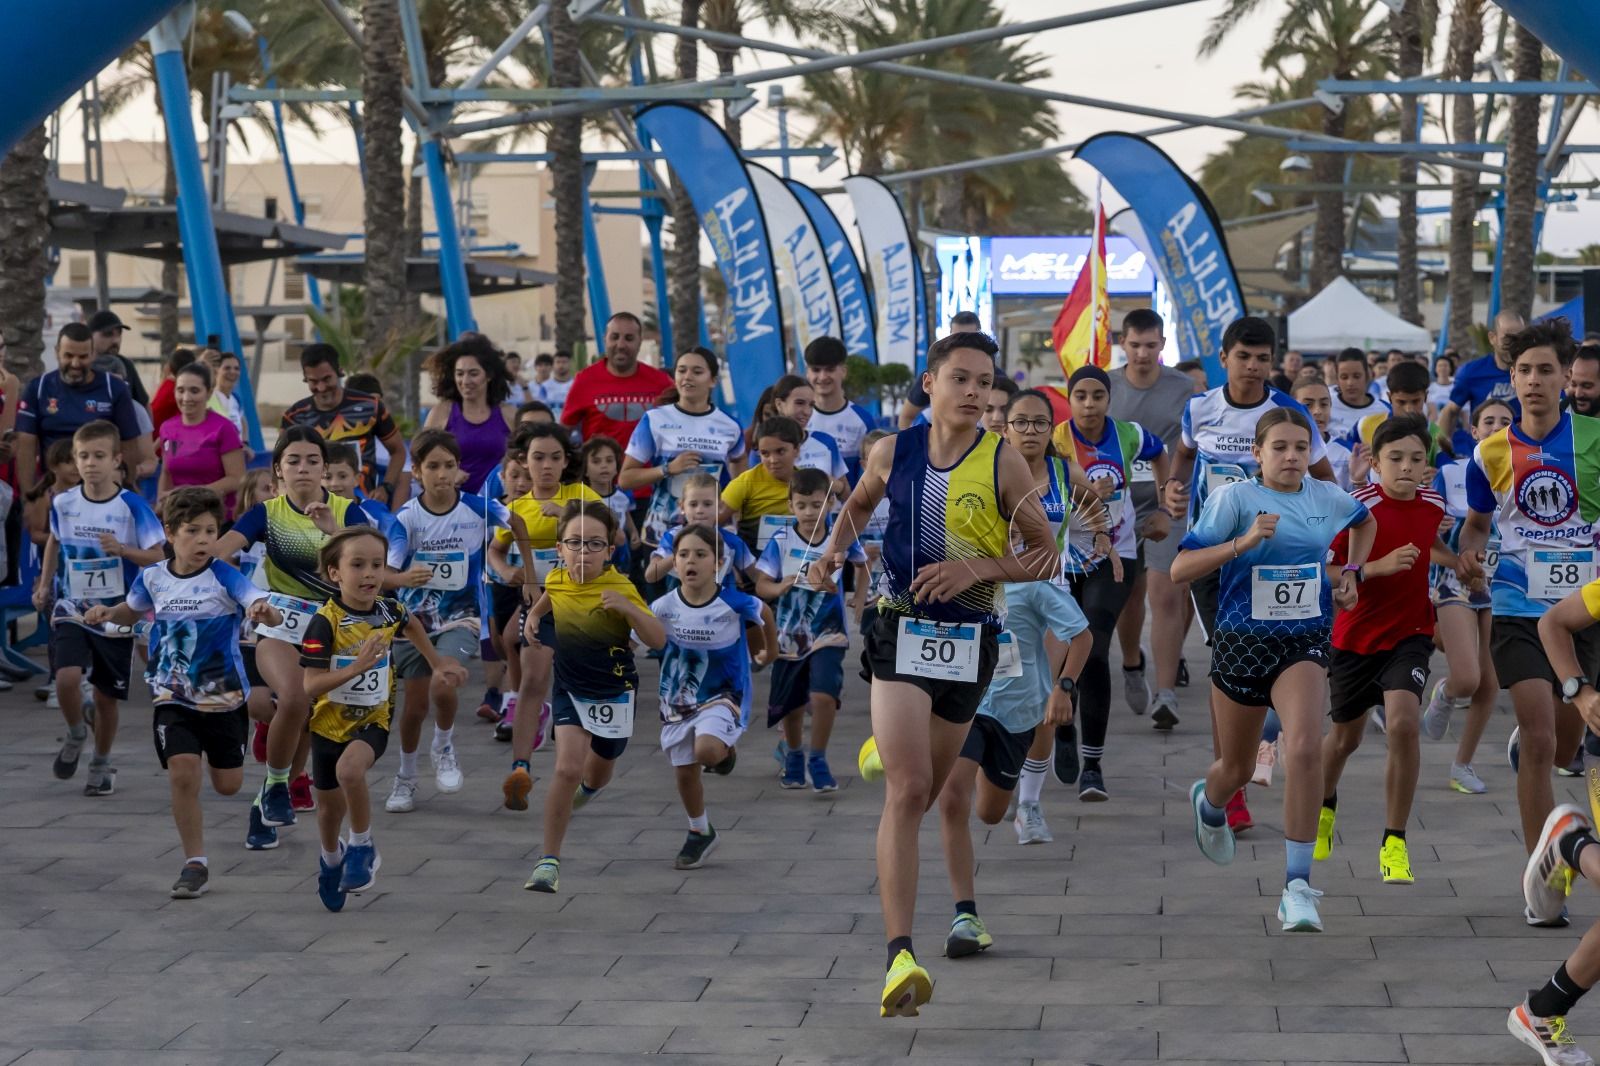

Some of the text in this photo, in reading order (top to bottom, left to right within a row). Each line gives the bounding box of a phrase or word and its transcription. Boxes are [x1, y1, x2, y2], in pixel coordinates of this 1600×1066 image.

[1000, 252, 1146, 273] MELILA
[1215, 444, 1251, 452] NOCTUR
[1228, 436, 1256, 445] CARRE
[1518, 470, 1574, 503] CAMPEONES PARA
[84, 571, 106, 587] 71
[427, 563, 453, 579] 79
[1549, 564, 1579, 585] 58
[1274, 582, 1306, 604] 67
[920, 638, 956, 664] 50
[350, 671, 379, 692] 23
[588, 704, 614, 724] 49
